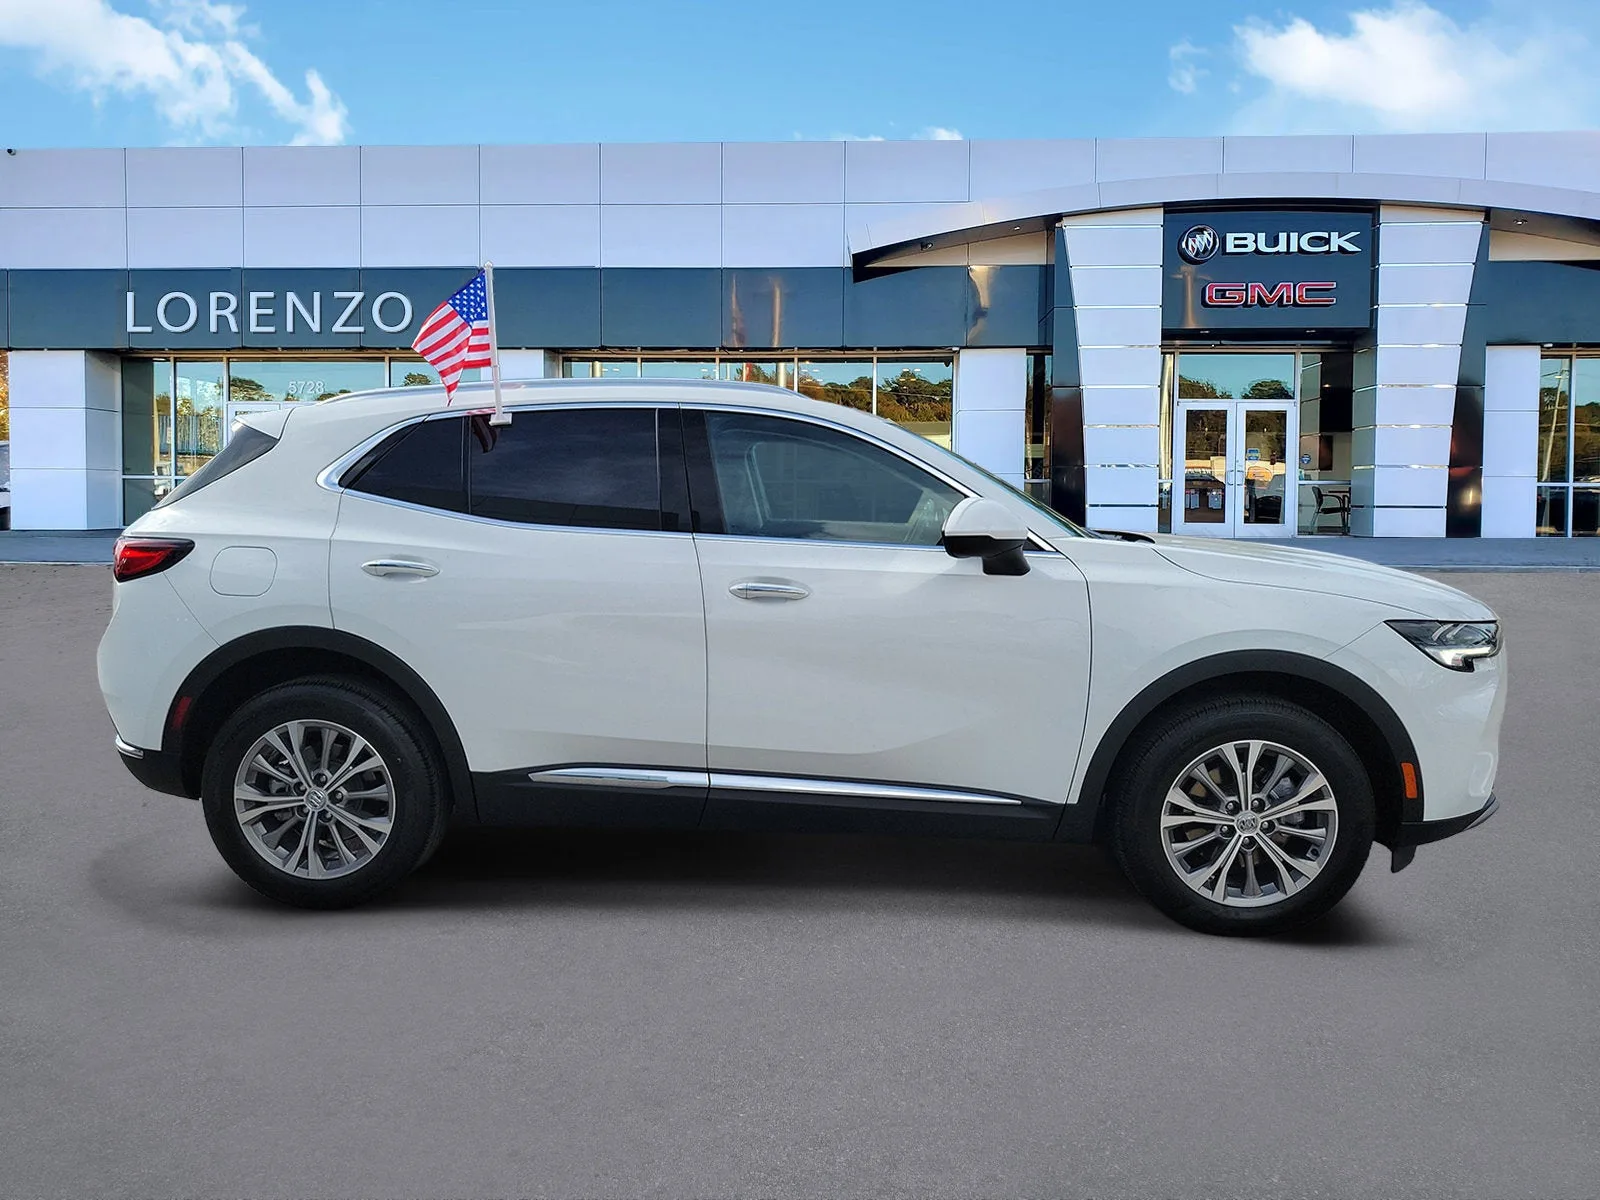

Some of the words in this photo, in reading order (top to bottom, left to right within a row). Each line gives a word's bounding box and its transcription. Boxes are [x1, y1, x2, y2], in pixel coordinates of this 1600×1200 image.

[1225, 231, 1362, 253] BUICK
[1206, 281, 1337, 305] GMC
[126, 291, 413, 334] LORENZO
[288, 380, 325, 394] 5728
